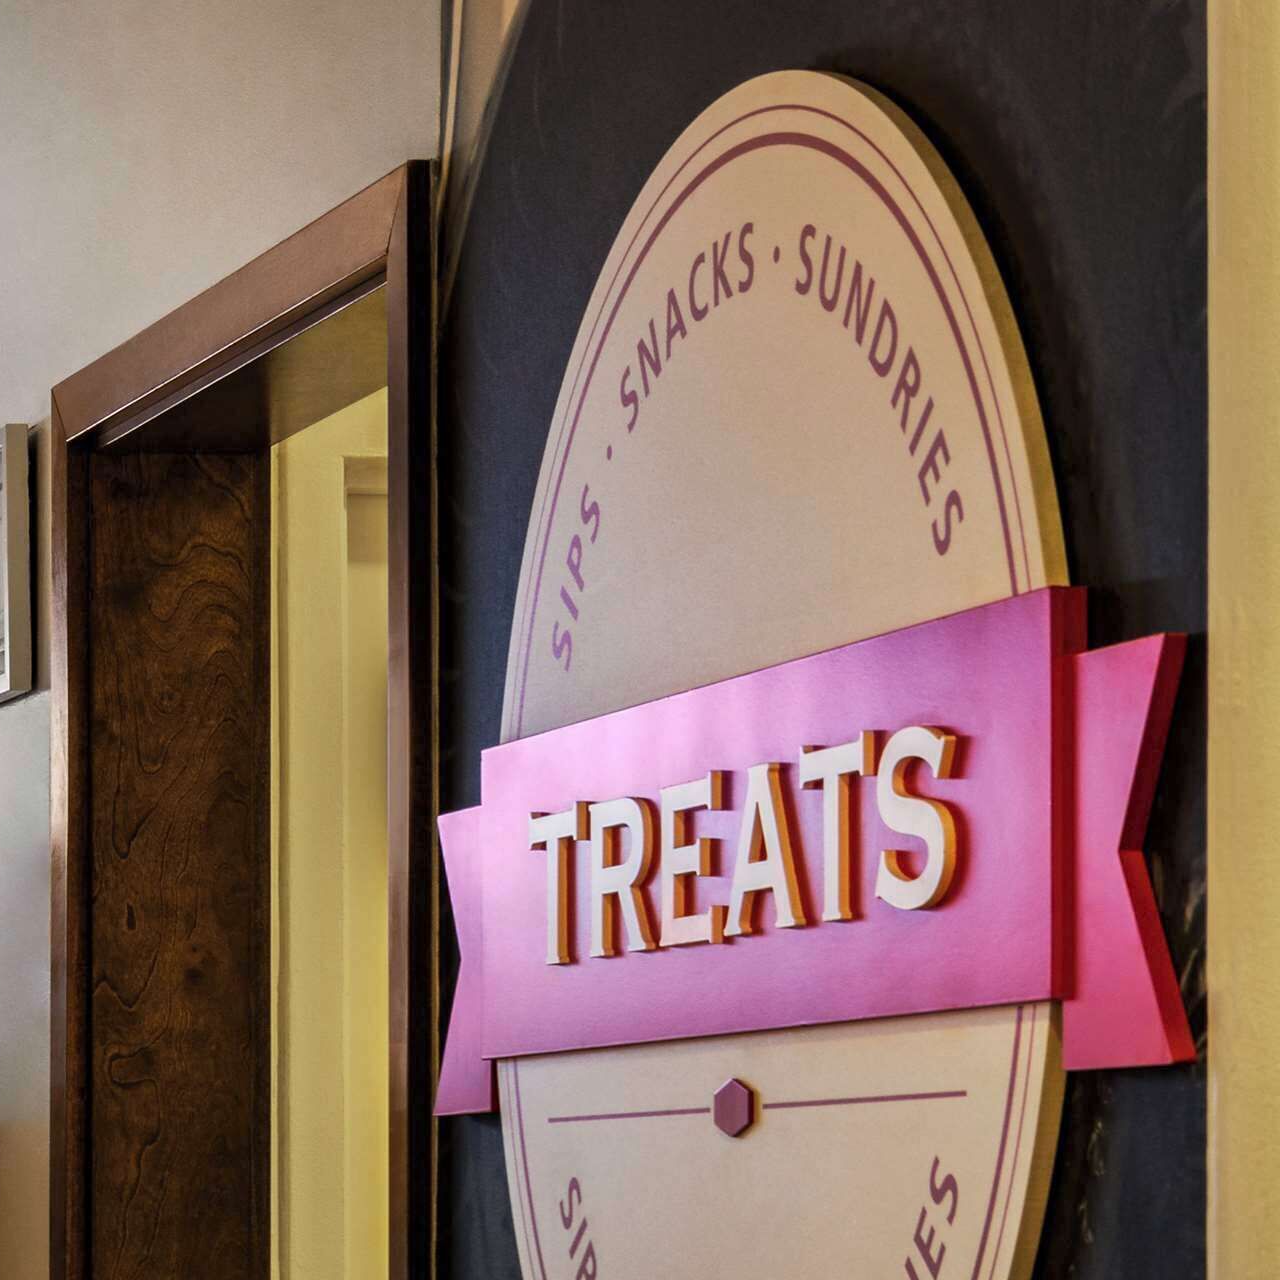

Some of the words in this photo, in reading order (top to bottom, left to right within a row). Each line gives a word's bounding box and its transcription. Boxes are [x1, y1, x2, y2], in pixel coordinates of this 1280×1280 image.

[551, 483, 602, 673] SIPS
[618, 221, 755, 434] SNACKS
[794, 223, 965, 557] SUNDRIES
[528, 723, 958, 966] TREATS
